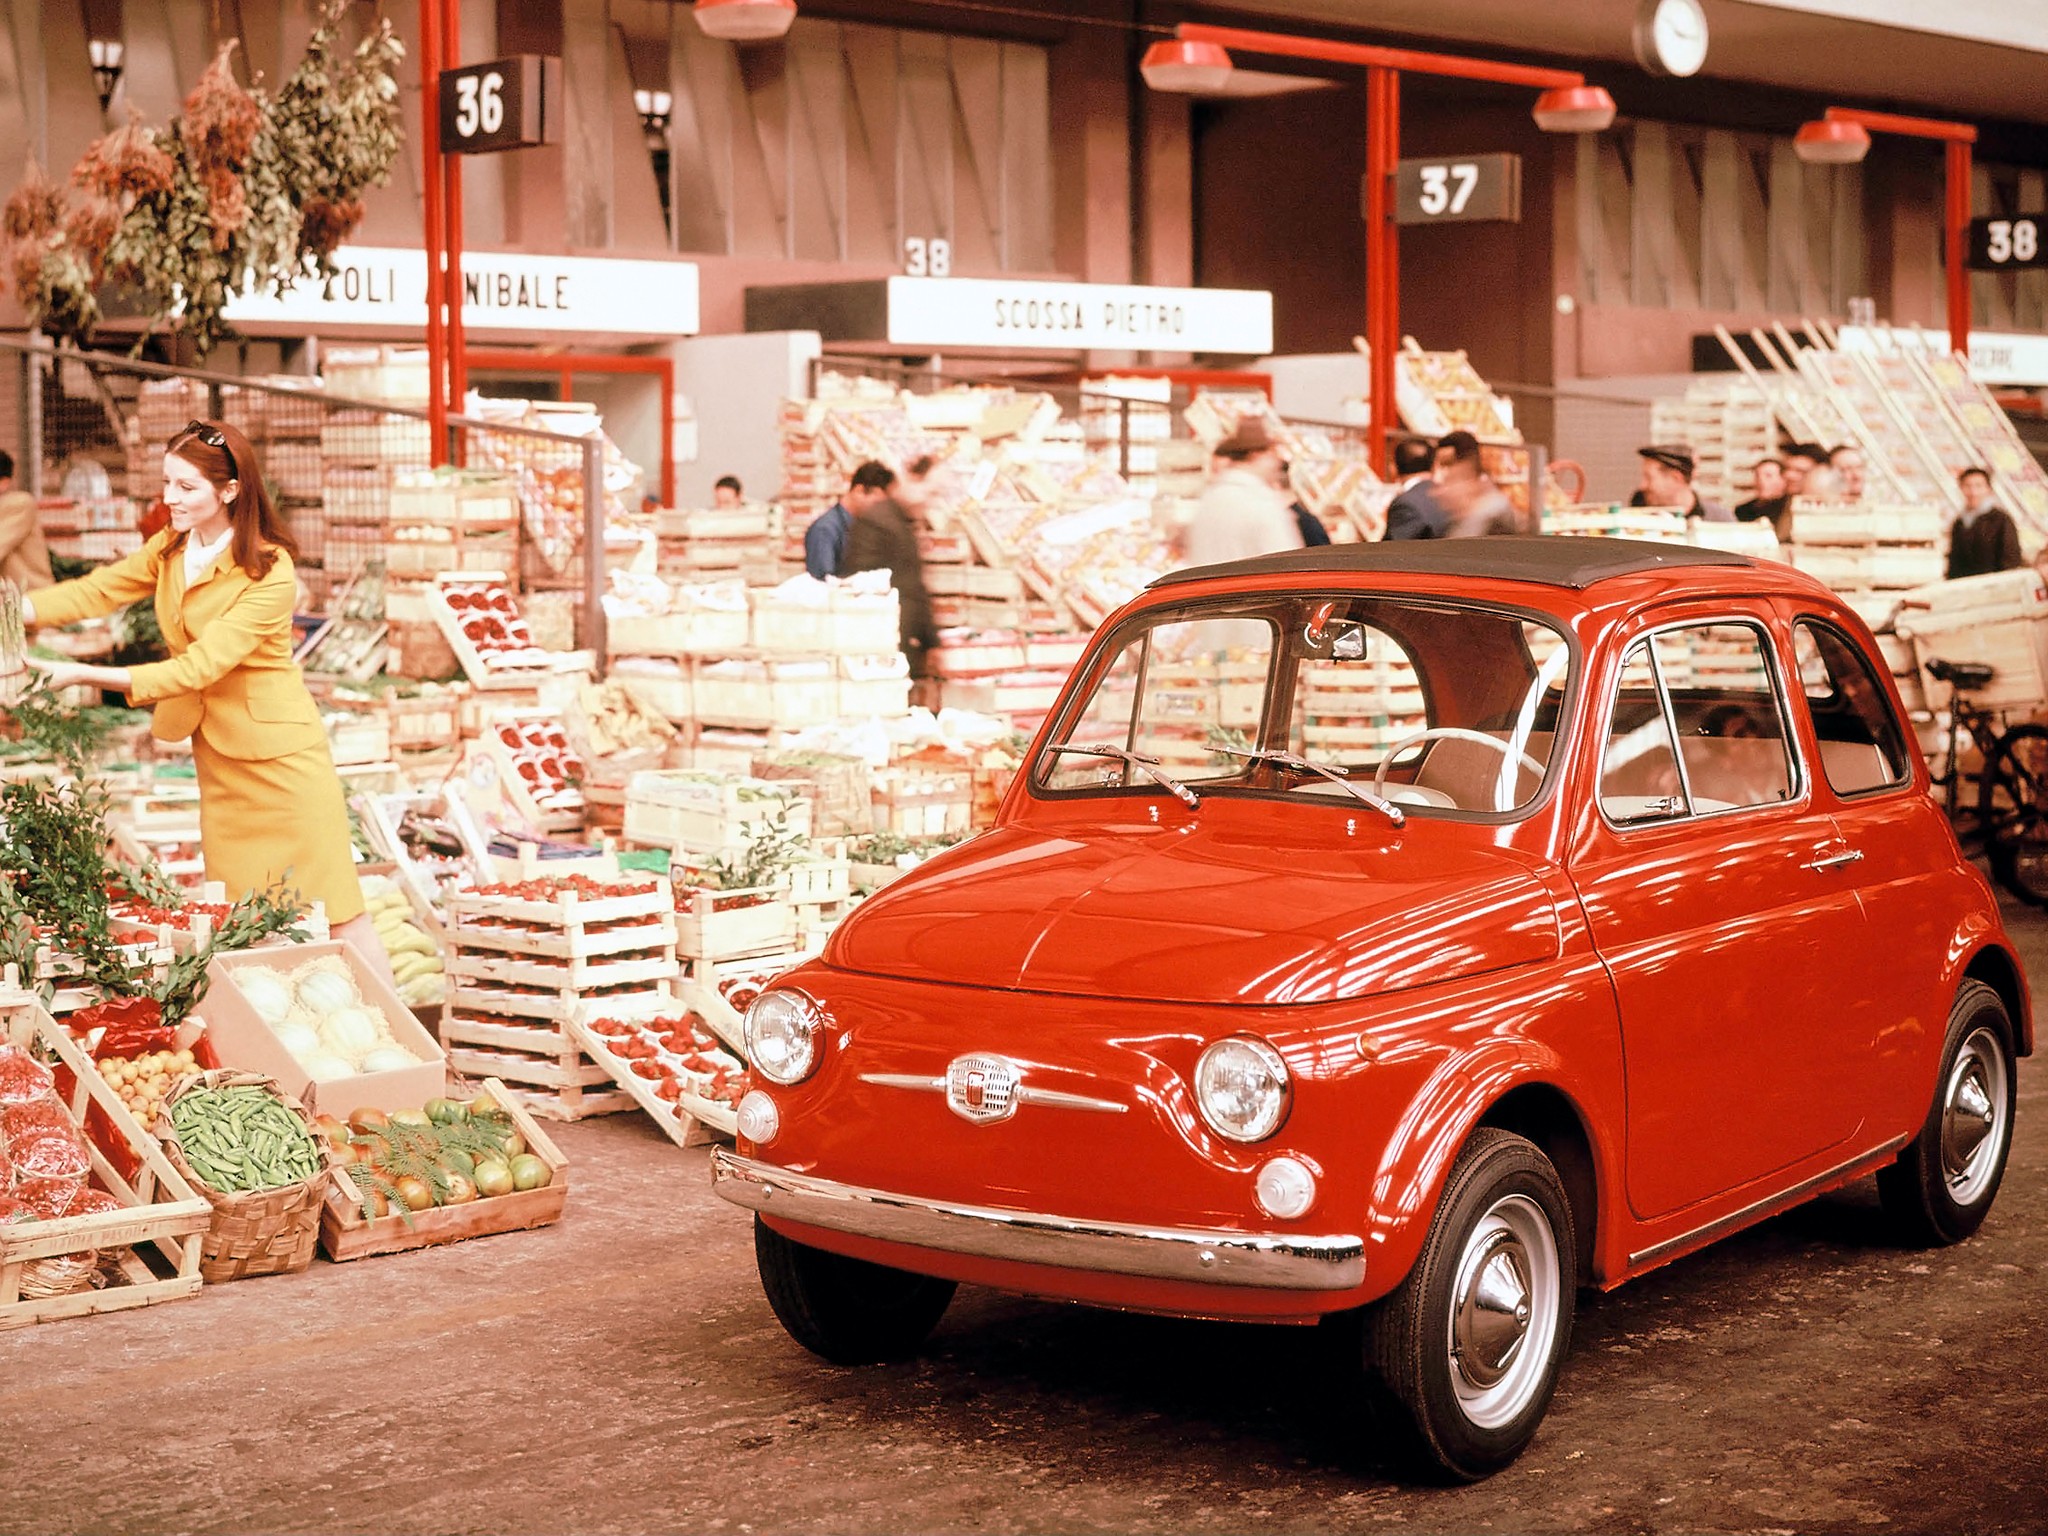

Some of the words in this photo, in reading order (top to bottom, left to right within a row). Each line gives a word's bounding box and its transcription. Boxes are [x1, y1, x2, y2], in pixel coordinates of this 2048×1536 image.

[456, 72, 504, 138] 36
[1419, 164, 1478, 215] 37
[905, 237, 950, 277] 38
[1988, 220, 2038, 264] 38
[466, 271, 570, 310] NIBALE
[995, 298, 1083, 329] SCOSSA
[1104, 302, 1185, 334] PIETRO
